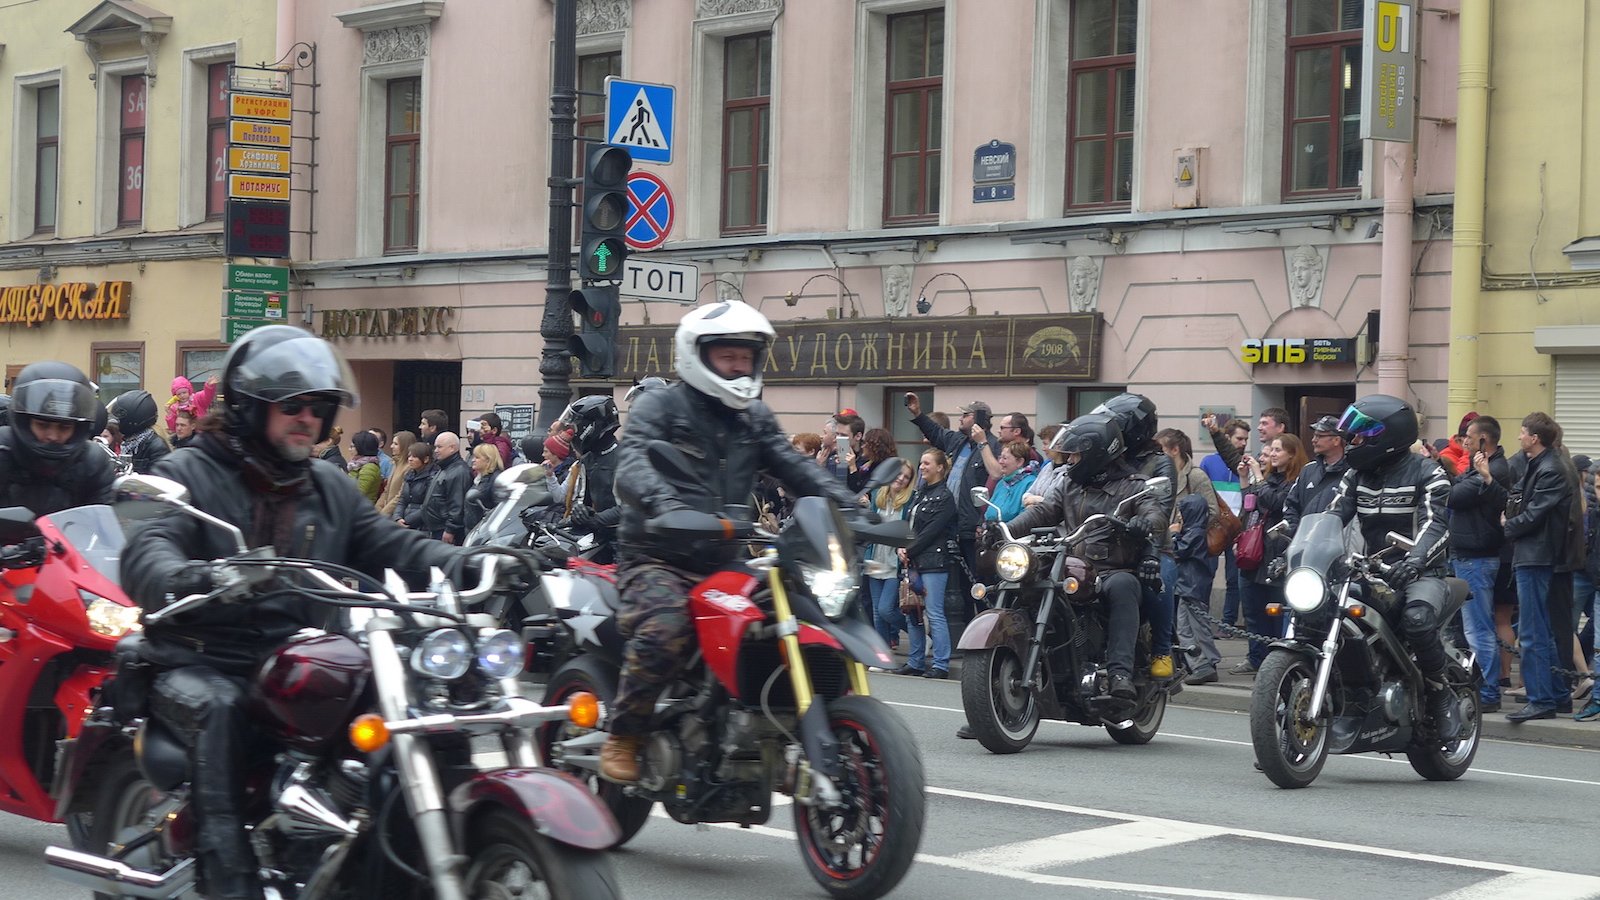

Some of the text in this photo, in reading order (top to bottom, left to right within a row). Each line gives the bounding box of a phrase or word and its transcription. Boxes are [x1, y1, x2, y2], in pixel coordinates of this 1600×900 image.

[254, 108, 276, 117] УФРС
[252, 124, 272, 134] Бюро
[243, 132, 280, 143] Переводов
[242, 151, 278, 161] Сейфовое
[981, 152, 1009, 165] НЕВСКИЙ
[240, 181, 281, 193] НОТАРИУС
[991, 187, 996, 198] 8
[321, 306, 454, 338] НОТАРИУС
[762, 330, 988, 377] ХУДОЖНИКА
[1041, 344, 1063, 357] 1908
